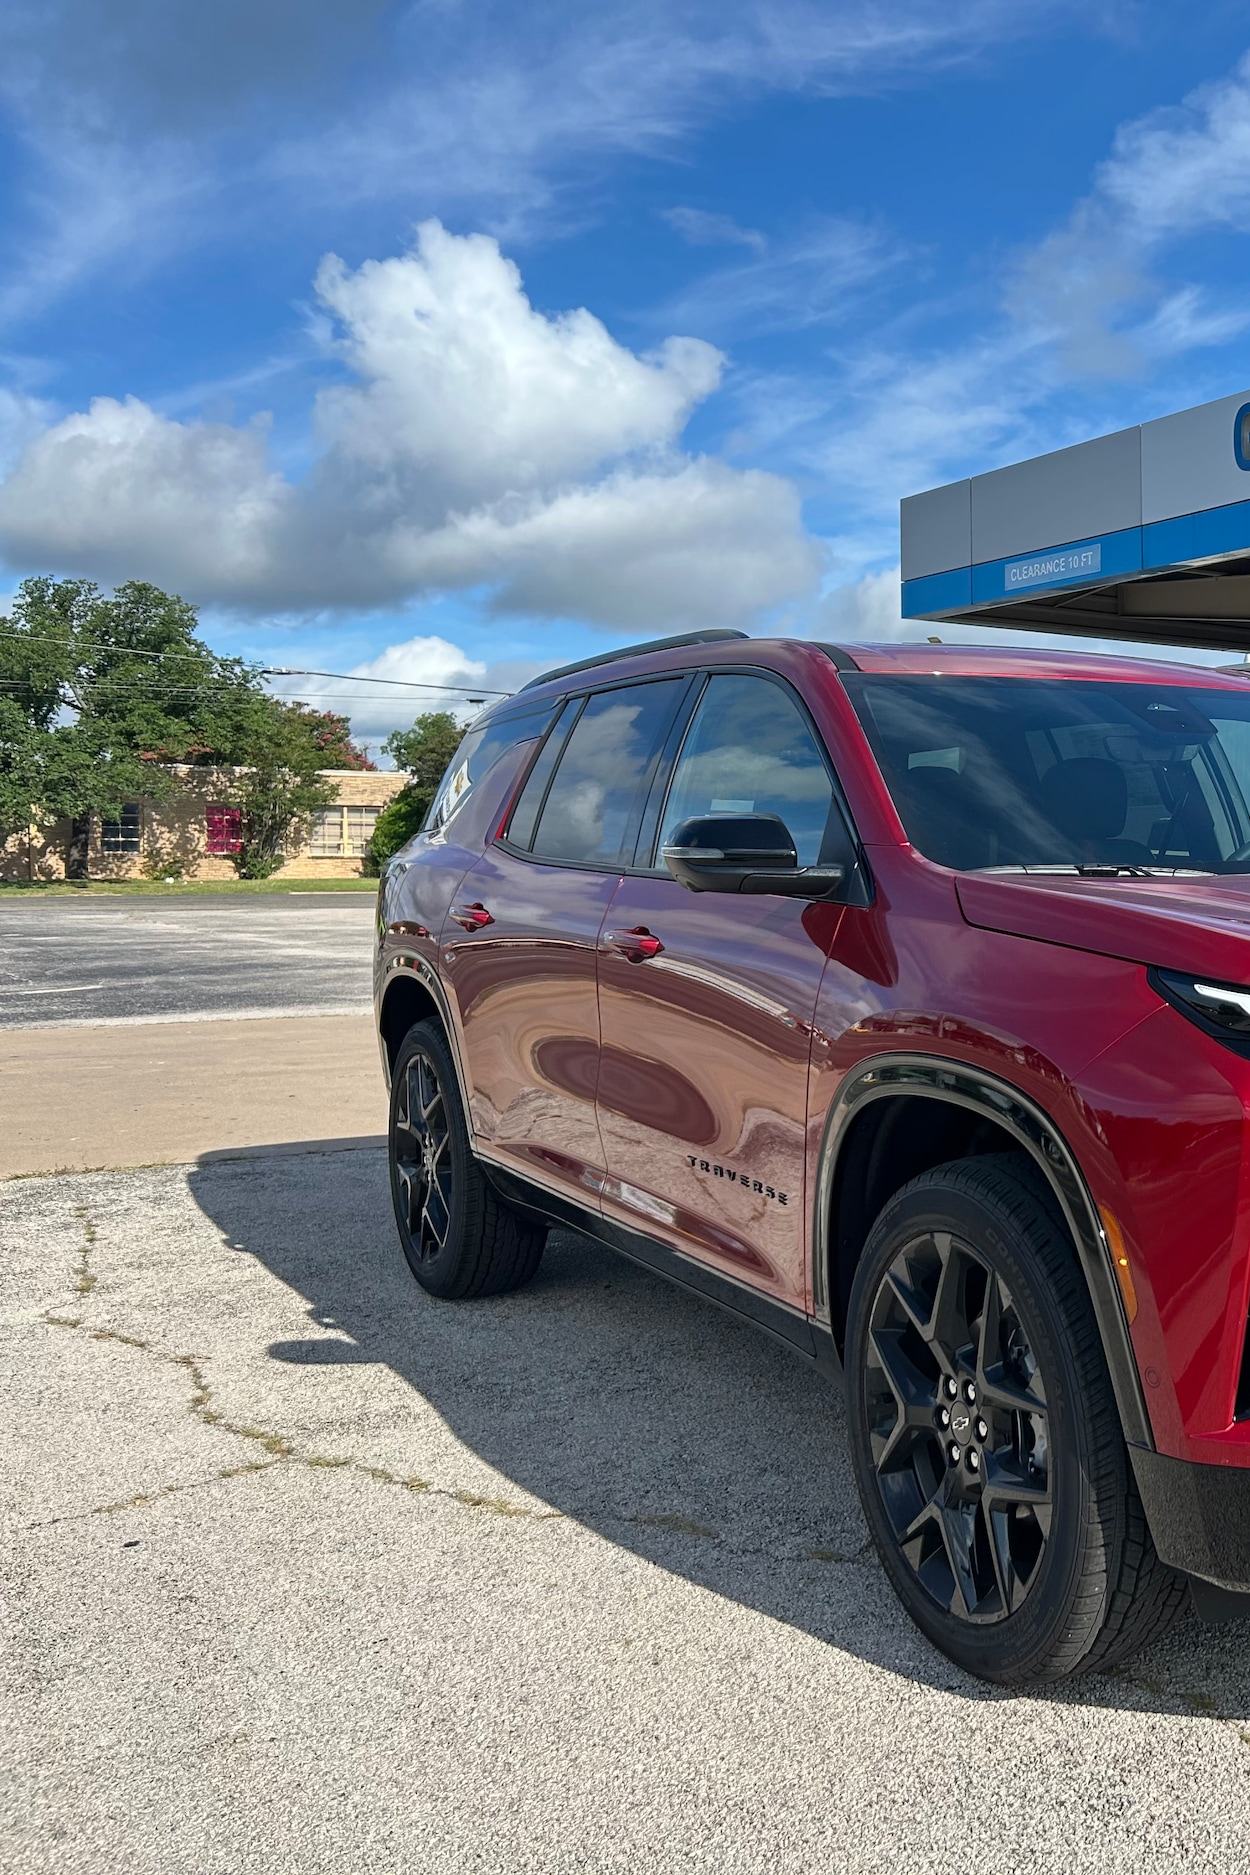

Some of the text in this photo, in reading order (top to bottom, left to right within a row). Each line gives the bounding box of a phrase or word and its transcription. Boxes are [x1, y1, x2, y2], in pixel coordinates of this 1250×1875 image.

[1010, 552, 1093, 582] CLEARANCE 10 FT
[687, 1155, 788, 1206] TRAVERSE
